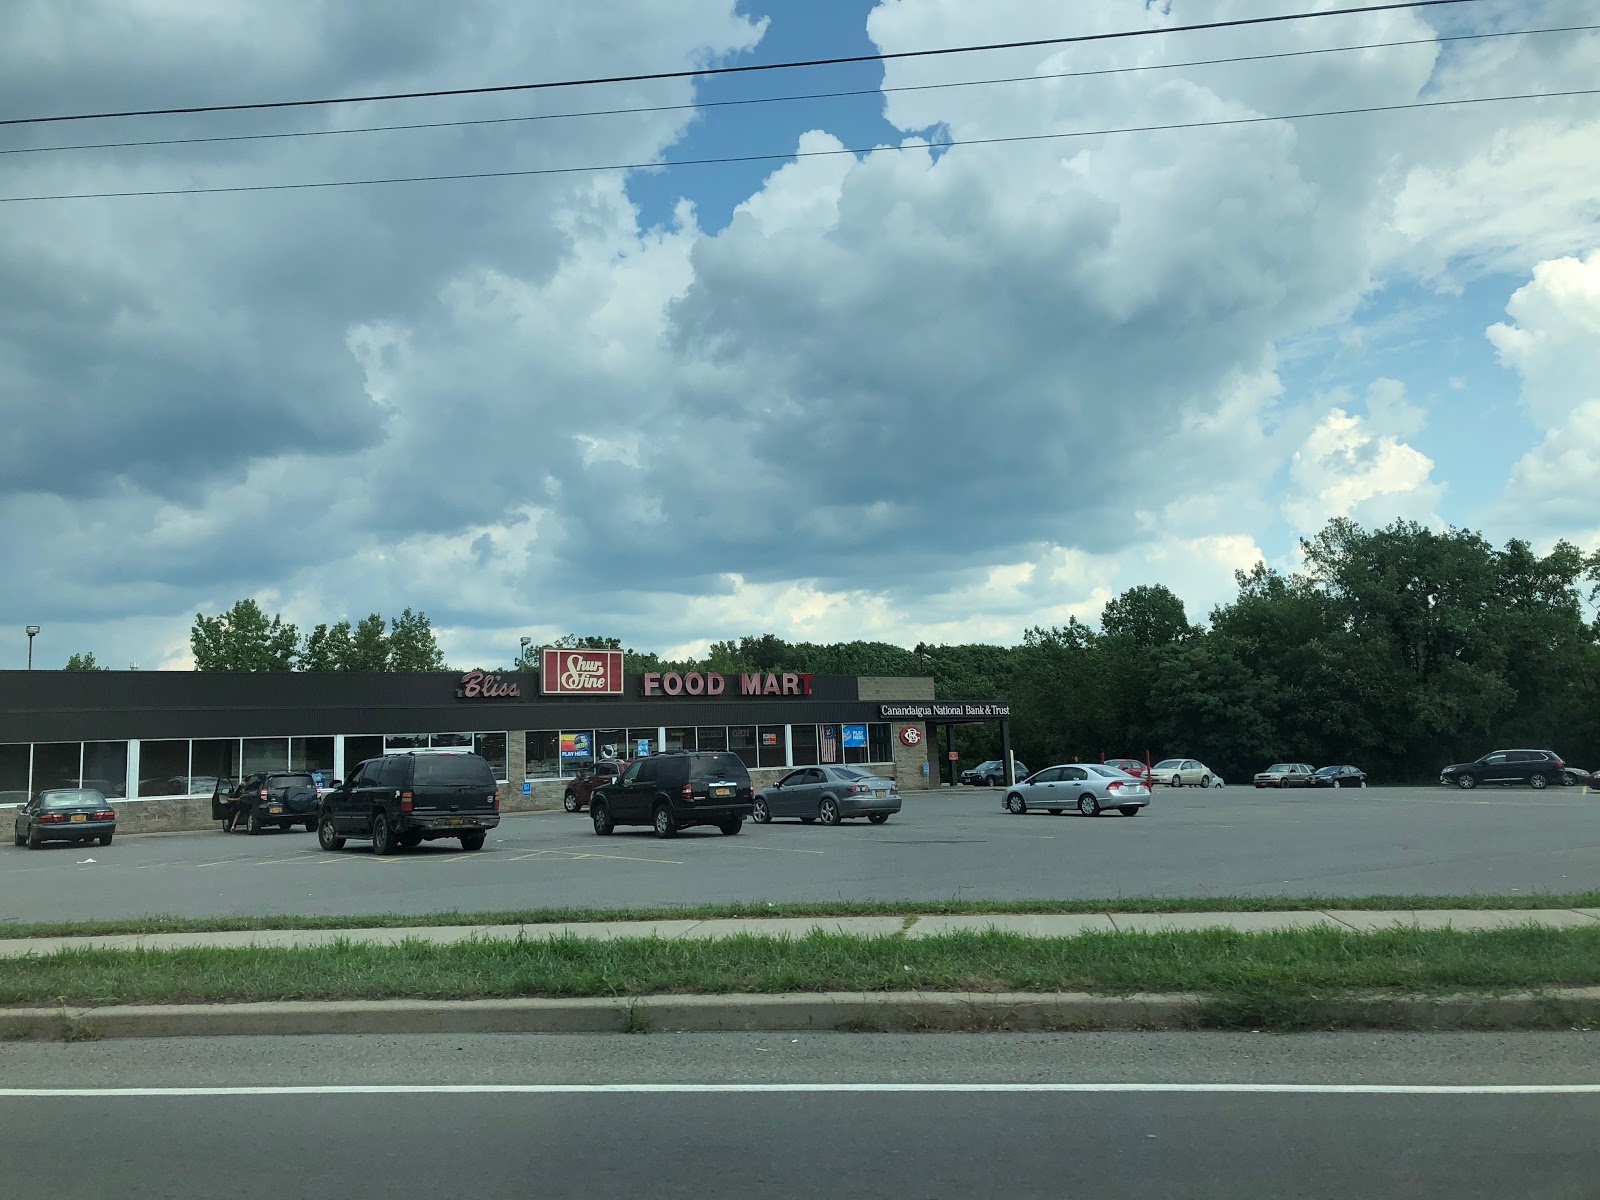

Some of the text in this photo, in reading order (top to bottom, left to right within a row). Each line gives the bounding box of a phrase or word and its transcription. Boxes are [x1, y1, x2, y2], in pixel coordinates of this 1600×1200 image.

[461, 671, 520, 697] Bliss
[644, 672, 814, 696] FOOD MART
[881, 705, 1010, 717] Canandaigua National Bank & Trust
